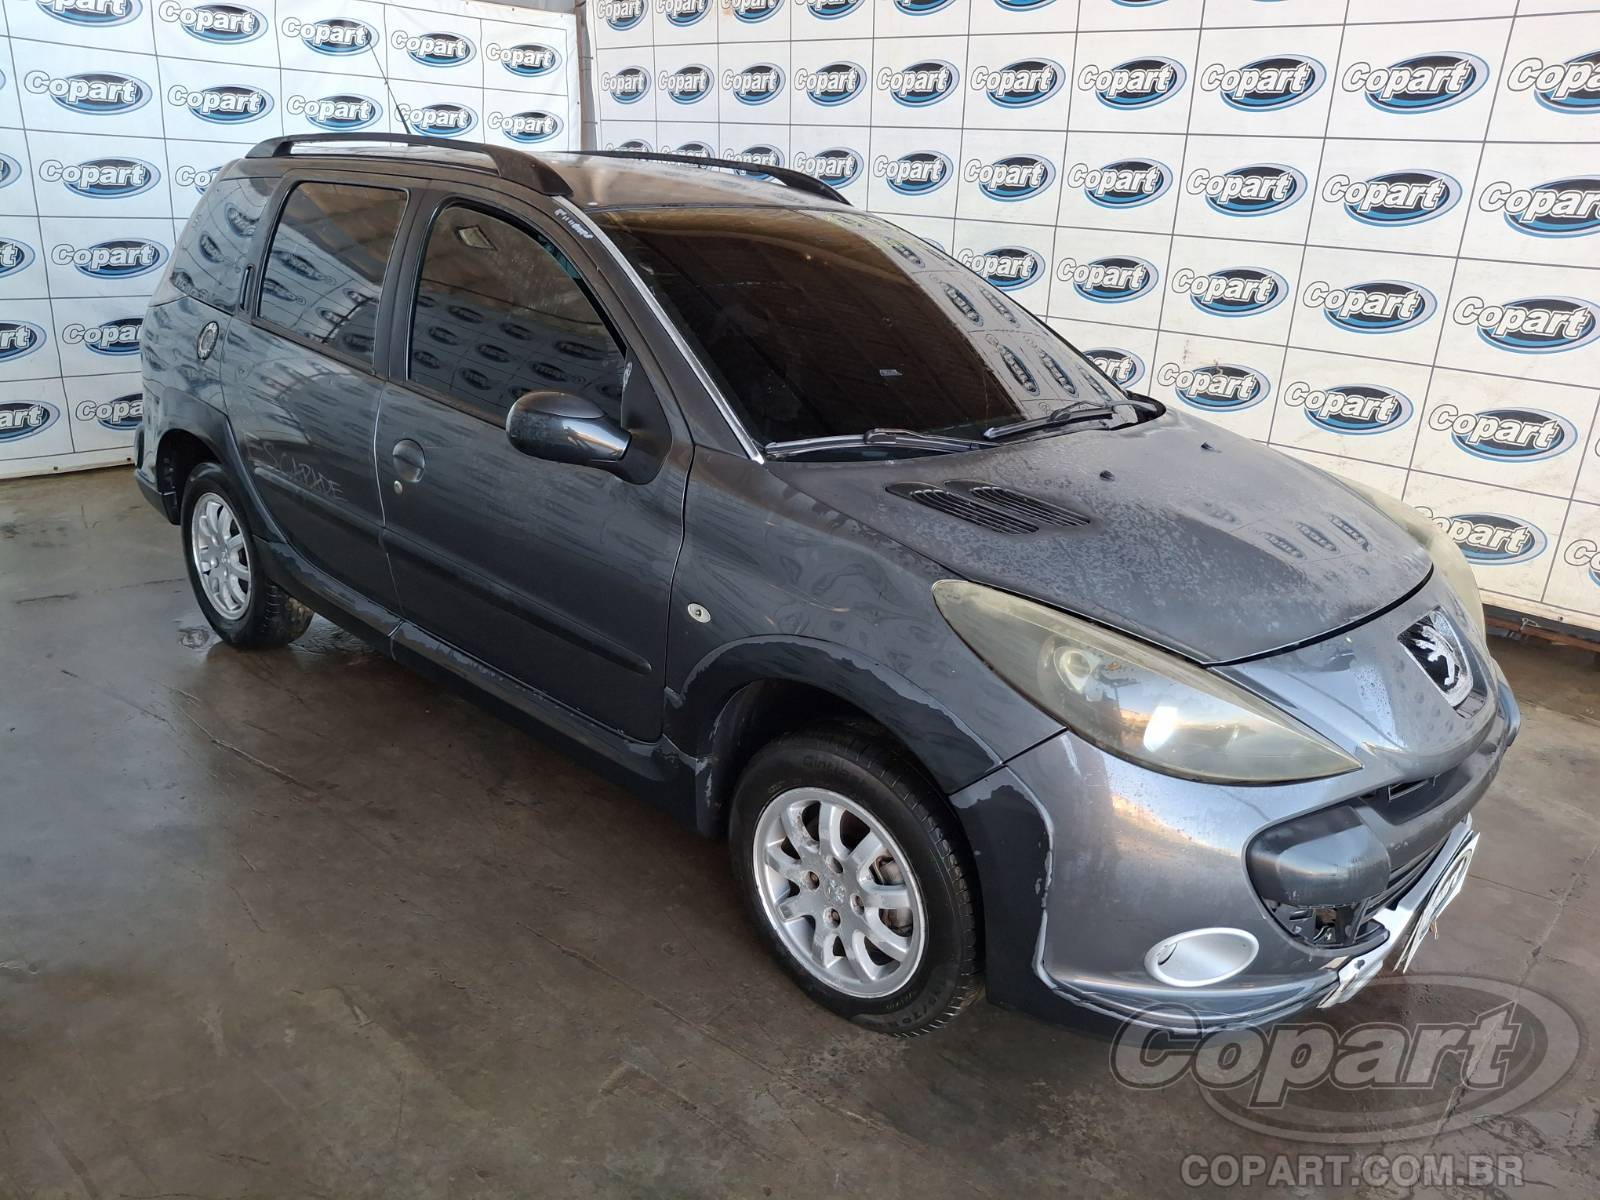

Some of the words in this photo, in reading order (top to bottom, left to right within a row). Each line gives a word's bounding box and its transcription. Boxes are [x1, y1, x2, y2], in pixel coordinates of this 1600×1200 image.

[159, 0, 255, 34] Copart
[281, 17, 369, 46] Copart
[391, 30, 467, 58] Copart
[486, 43, 554, 68] Copart
[24, 70, 137, 104] Copart
[600, 71, 646, 97] Copart
[658, 71, 707, 96] Copart
[721, 69, 778, 96] Copart
[794, 66, 857, 96] Copart
[876, 63, 950, 96] Copart
[970, 63, 1055, 98] Copart
[1077, 63, 1174, 98] Copart
[1200, 61, 1312, 100] Copart
[1342, 58, 1473, 100] Copart
[1507, 57, 1600, 100] Cop
[167, 85, 262, 114] Copart
[286, 95, 372, 121] Copart
[394, 103, 470, 130] Copart
[487, 111, 554, 136] Copart
[39, 160, 146, 190] Copart
[793, 152, 857, 179] Copart
[873, 155, 944, 184] Copart
[964, 158, 1046, 190] Copart
[1067, 162, 1161, 195] Copart
[1186, 168, 1294, 203] Copart
[1322, 174, 1447, 214] Copart
[1479, 181, 1600, 224] Copar
[51, 243, 155, 271] Copart
[1057, 258, 1147, 291] Copart
[1172, 268, 1274, 304] Copart
[1302, 281, 1421, 320] Copart
[1453, 296, 1590, 340] Copart
[62, 323, 142, 349] Copa
[1157, 362, 1258, 400] Copart
[76, 400, 143, 424] Copa
[1284, 381, 1400, 423] Copart
[1429, 404, 1560, 448] Copart
